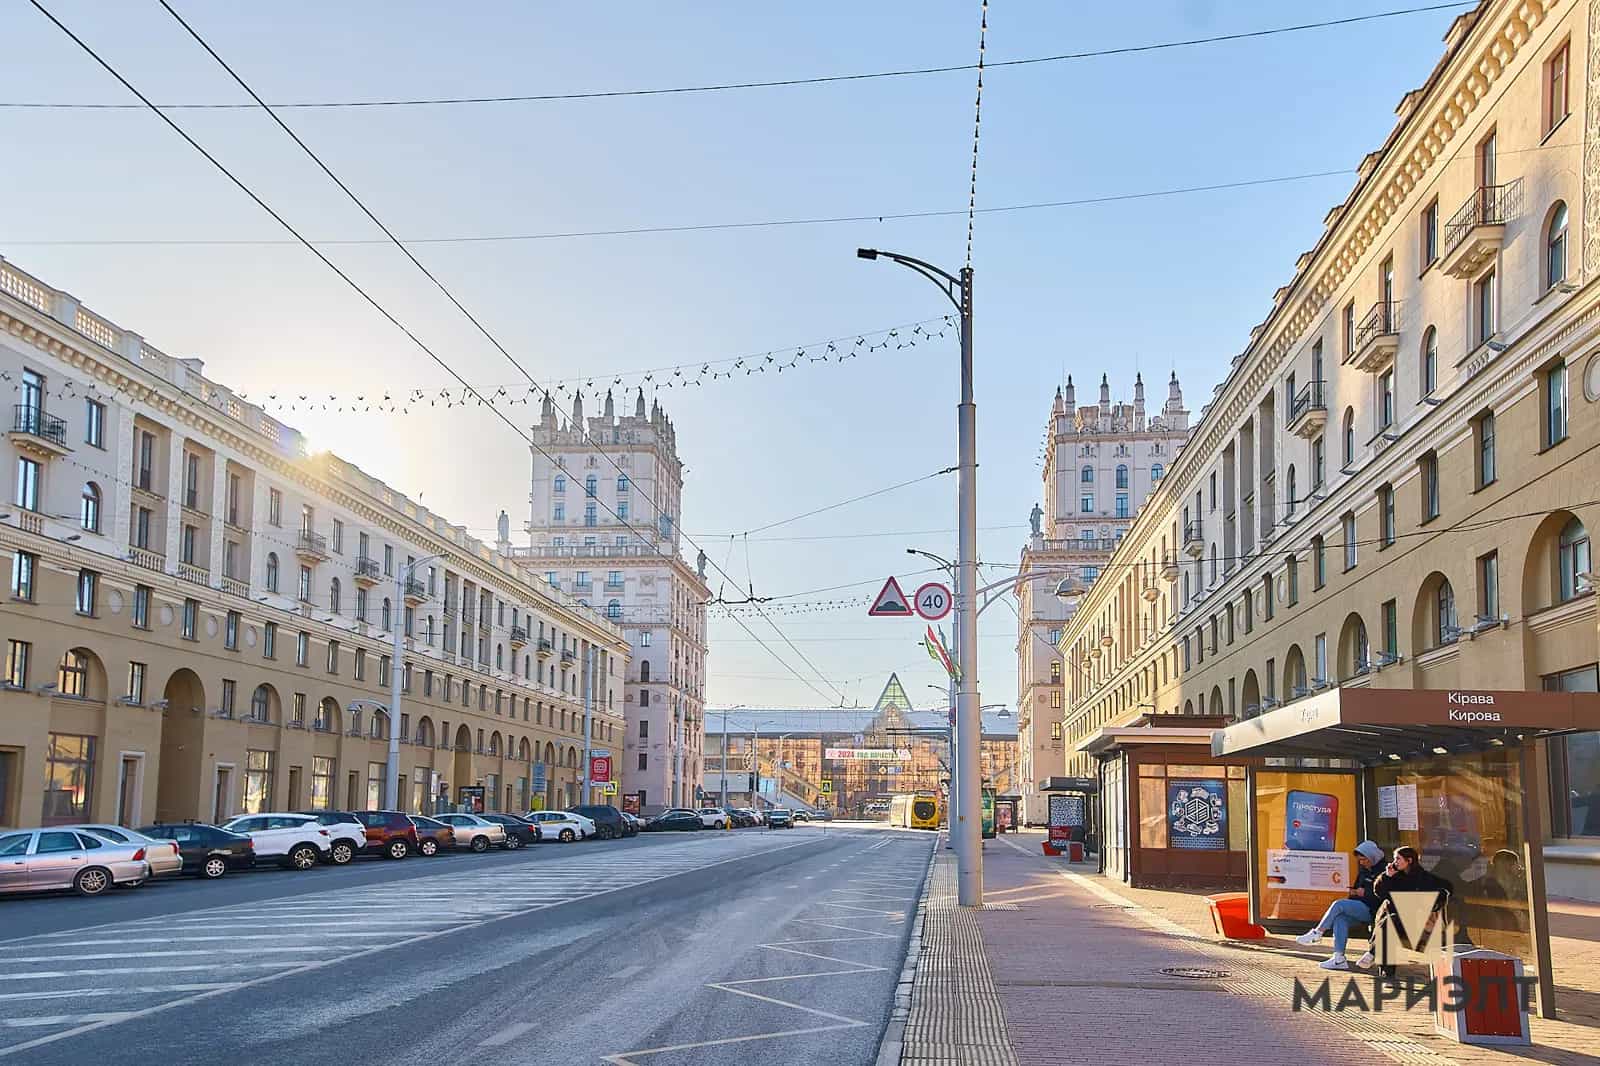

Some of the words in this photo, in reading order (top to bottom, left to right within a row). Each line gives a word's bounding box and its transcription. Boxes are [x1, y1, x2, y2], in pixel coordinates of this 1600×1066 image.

[922, 594, 943, 608] 40
[1448, 691, 1495, 706] Кірава
[1449, 709, 1501, 723] Кирова
[838, 750, 855, 758] 2024
